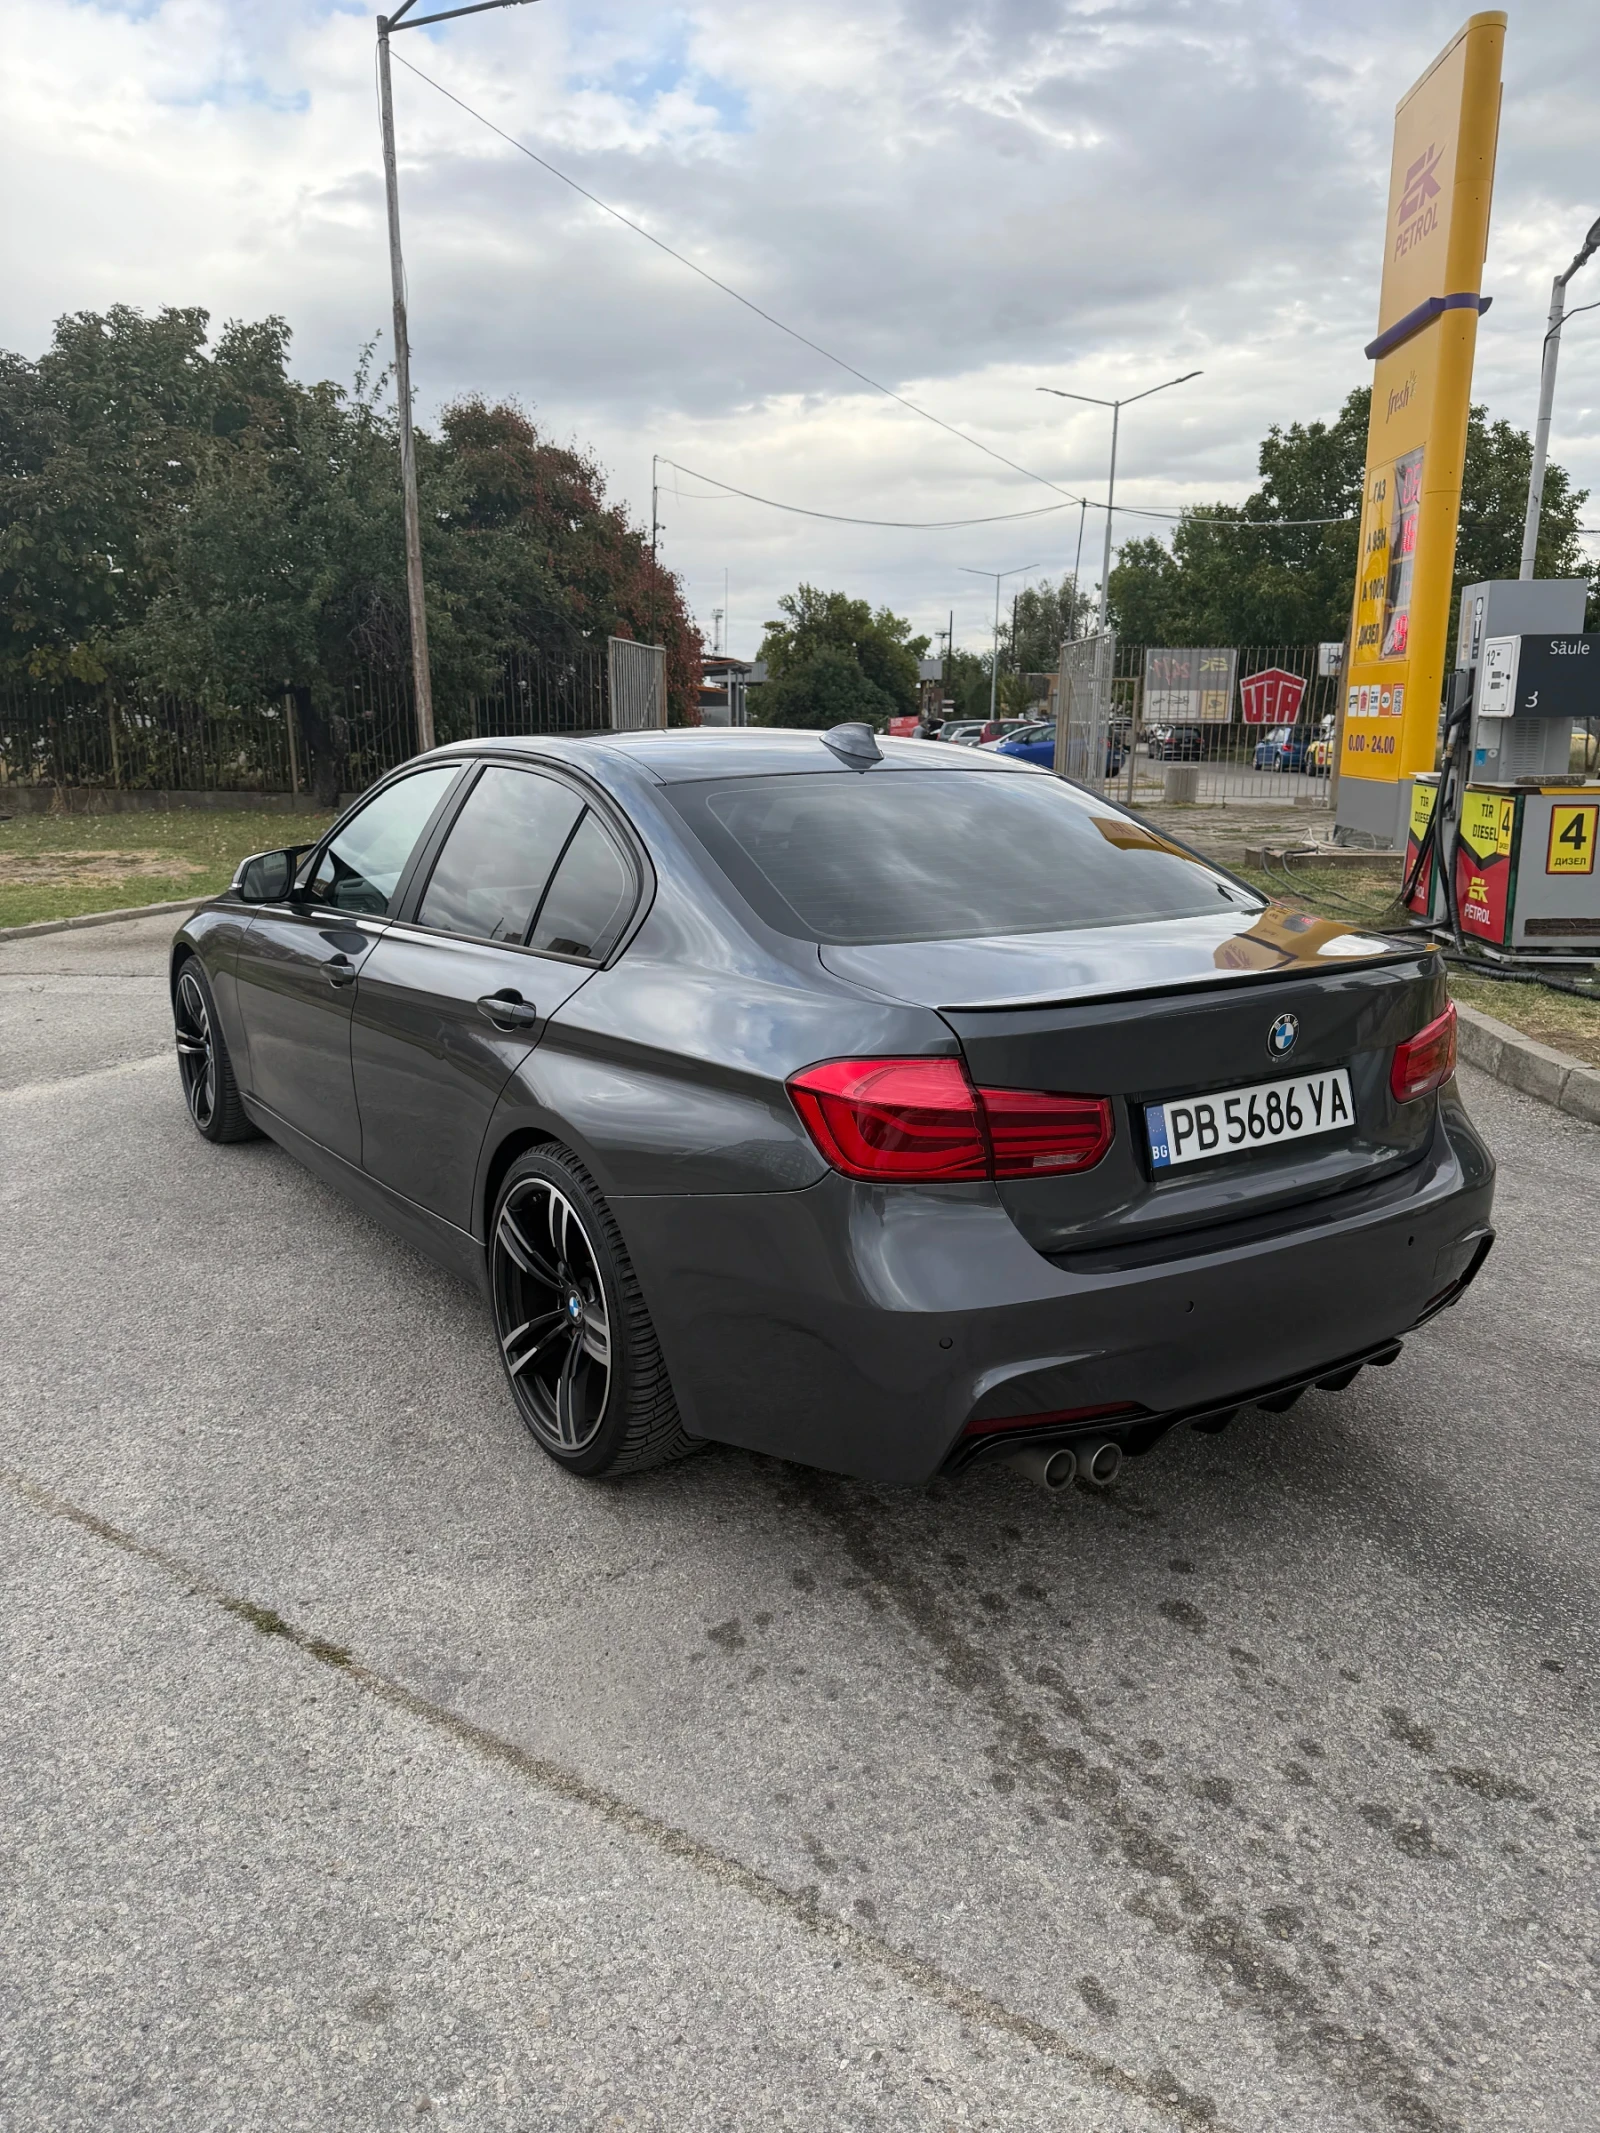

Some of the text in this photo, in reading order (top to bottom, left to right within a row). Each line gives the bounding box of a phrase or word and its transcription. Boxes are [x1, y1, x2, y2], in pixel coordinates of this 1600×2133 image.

[1395, 142, 1446, 227] EK
[1394, 202, 1439, 263] PETROL
[1386, 380, 1410, 424] fresh
[1549, 640, 1590, 655] Säule
[1525, 691, 1539, 708] 3
[1348, 734, 1365, 752] 0.00
[1371, 735, 1395, 754] 24.00
[1414, 811, 1430, 824] DIESE
[1481, 803, 1494, 819] TIR
[1472, 824, 1498, 841] DIESEL
[1501, 806, 1511, 838] 4
[1559, 813, 1587, 850] 4
[1554, 857, 1587, 866] ДИЗЕЛ
[1467, 877, 1490, 903] EK
[1464, 903, 1491, 925] PETROL
[1171, 1078, 1348, 1156] PB 5686 YA
[1152, 1145, 1168, 1160] BG
